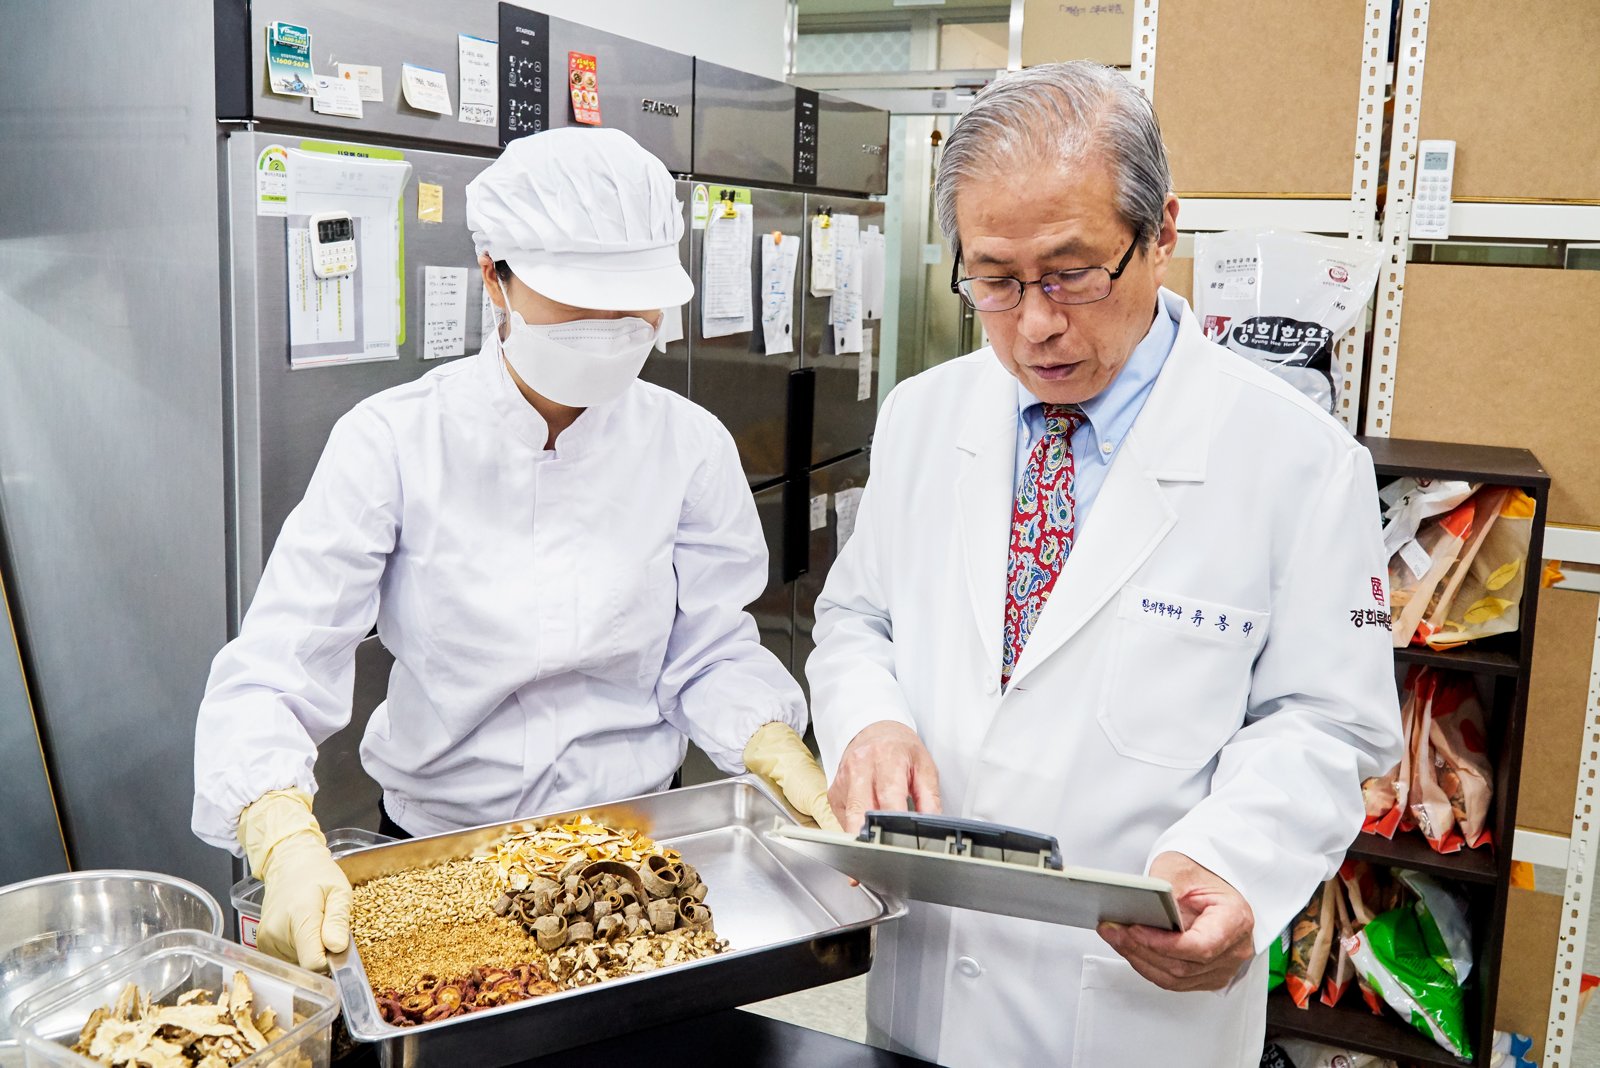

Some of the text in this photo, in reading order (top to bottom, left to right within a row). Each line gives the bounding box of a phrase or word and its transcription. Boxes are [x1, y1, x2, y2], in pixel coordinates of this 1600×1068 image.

[276, 57, 310, 69] 1600-5678
[641, 98, 680, 117] STARION
[1239, 322, 1329, 347] 경희한약
[1251, 338, 1269, 346] Kyung
[1141, 598, 1183, 620] 한의학박사
